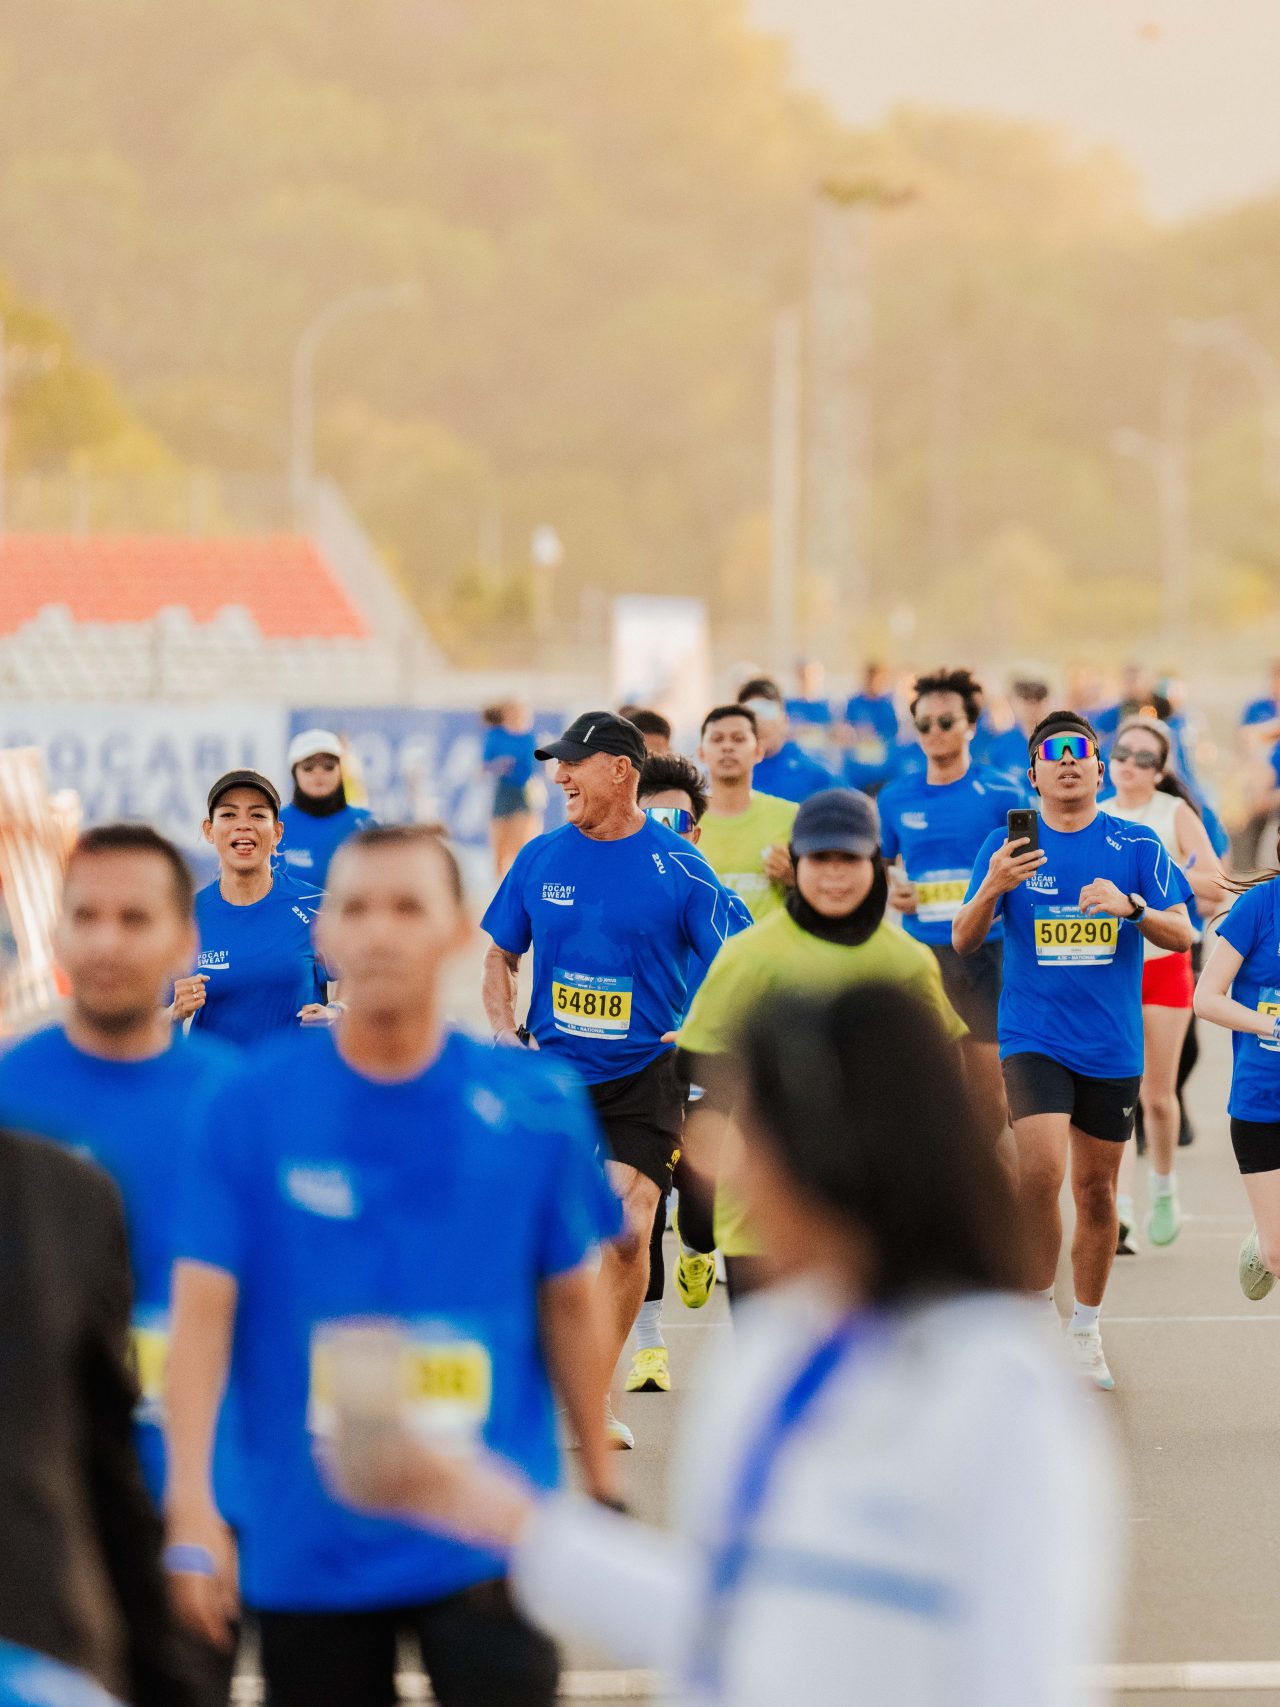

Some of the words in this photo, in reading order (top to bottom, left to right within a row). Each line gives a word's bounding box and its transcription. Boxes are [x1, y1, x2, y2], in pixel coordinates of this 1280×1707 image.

[2, 731, 258, 782] OCARI
[652, 853, 666, 874] 2XU
[541, 891, 572, 899] SWEAT
[542, 885, 576, 893] POCARI
[291, 905, 310, 924] 2XU
[1041, 922, 1112, 944] 50290
[557, 987, 622, 1017] 54818
